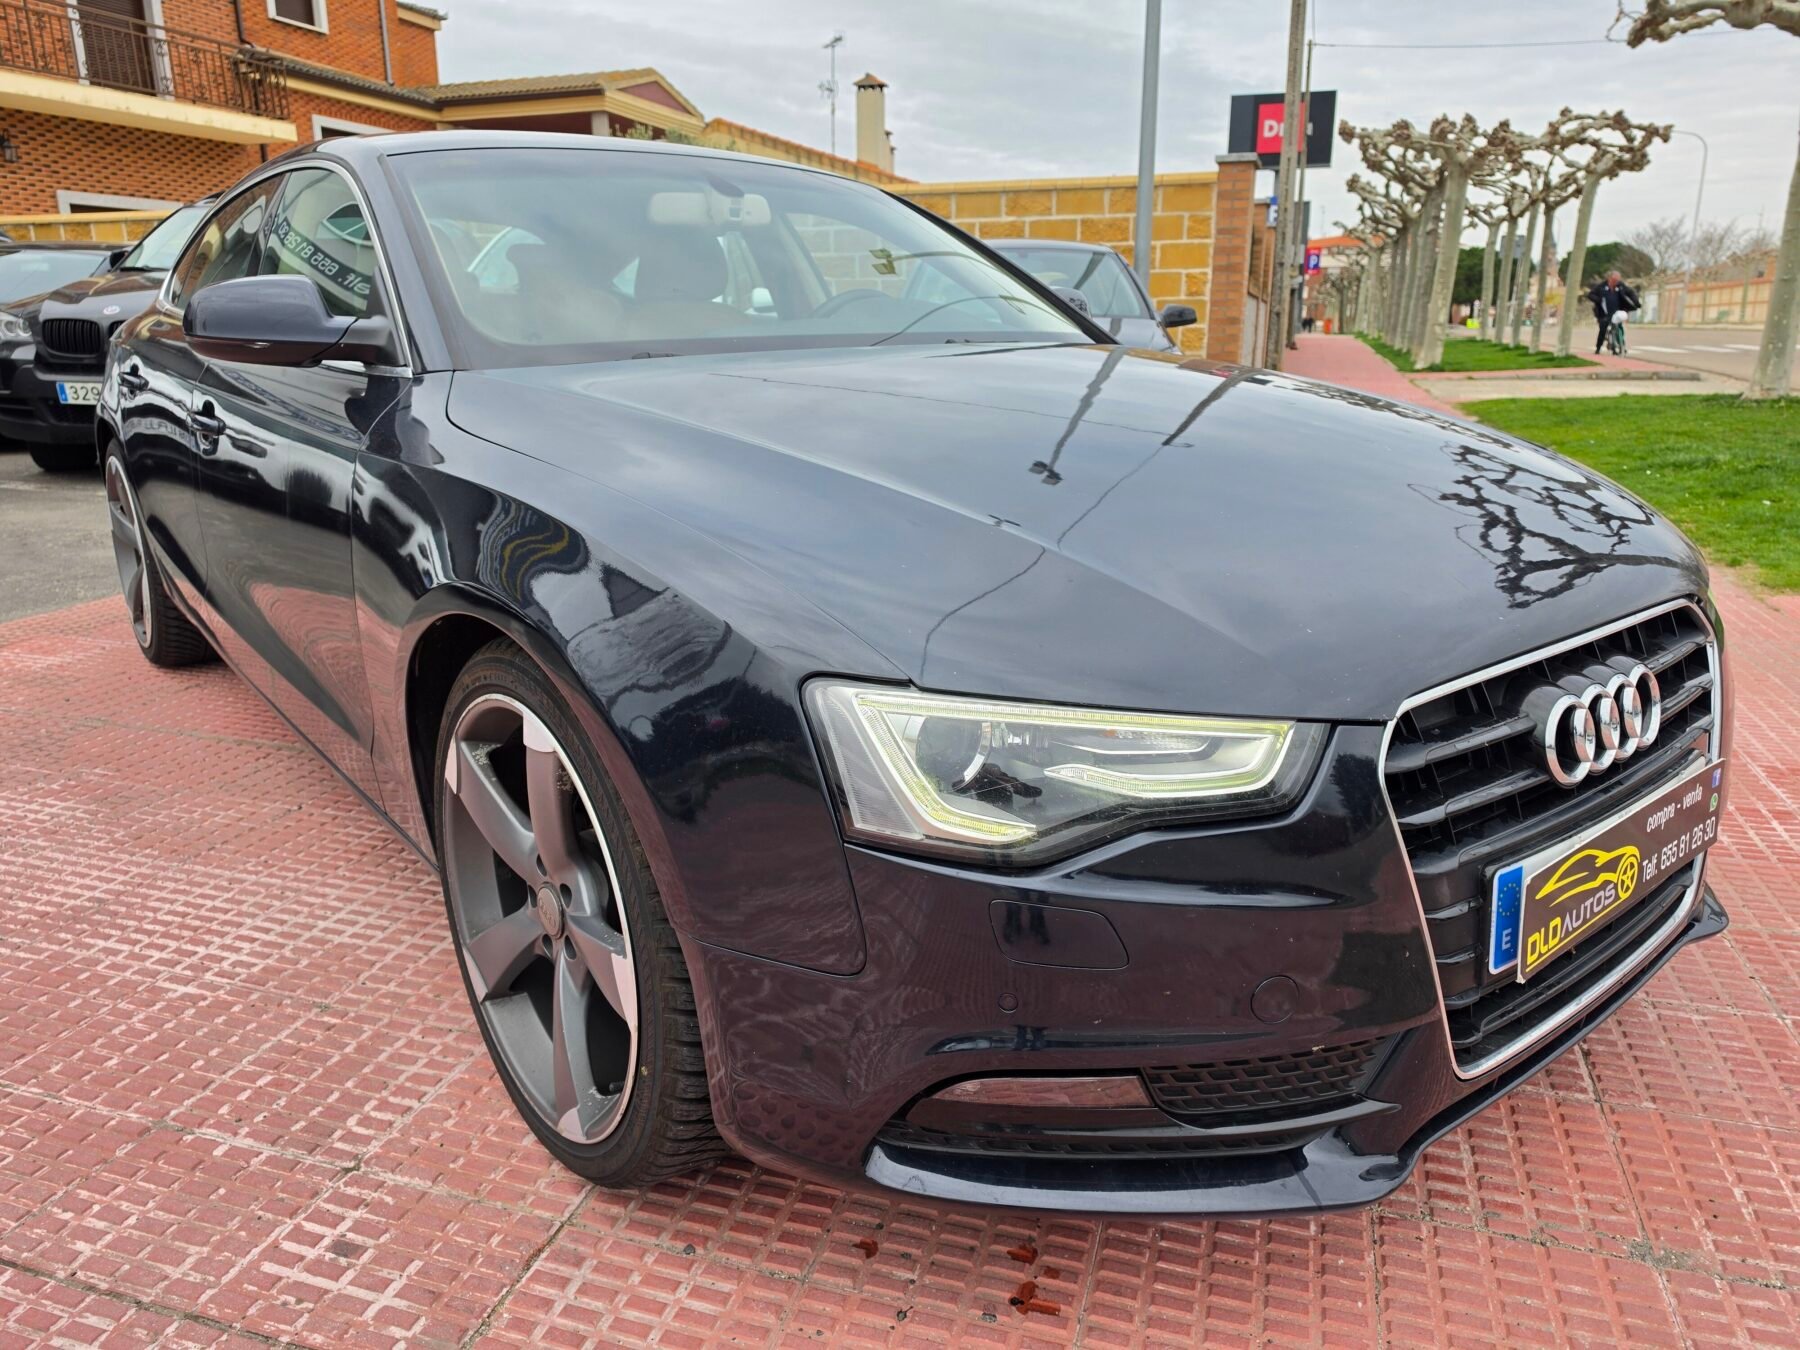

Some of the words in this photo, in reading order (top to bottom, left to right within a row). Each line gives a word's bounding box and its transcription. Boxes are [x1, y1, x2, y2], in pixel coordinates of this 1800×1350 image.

[1309, 254, 1319, 269] P
[1646, 803, 1676, 833] compra
[1682, 783, 1703, 810] venta
[1642, 853, 1658, 883] Telf.
[1660, 840, 1678, 870] 655
[1679, 832, 1690, 858] 81
[1691, 824, 1703, 850] 26
[1704, 816, 1716, 841] 30
[1502, 928, 1512, 951] E
